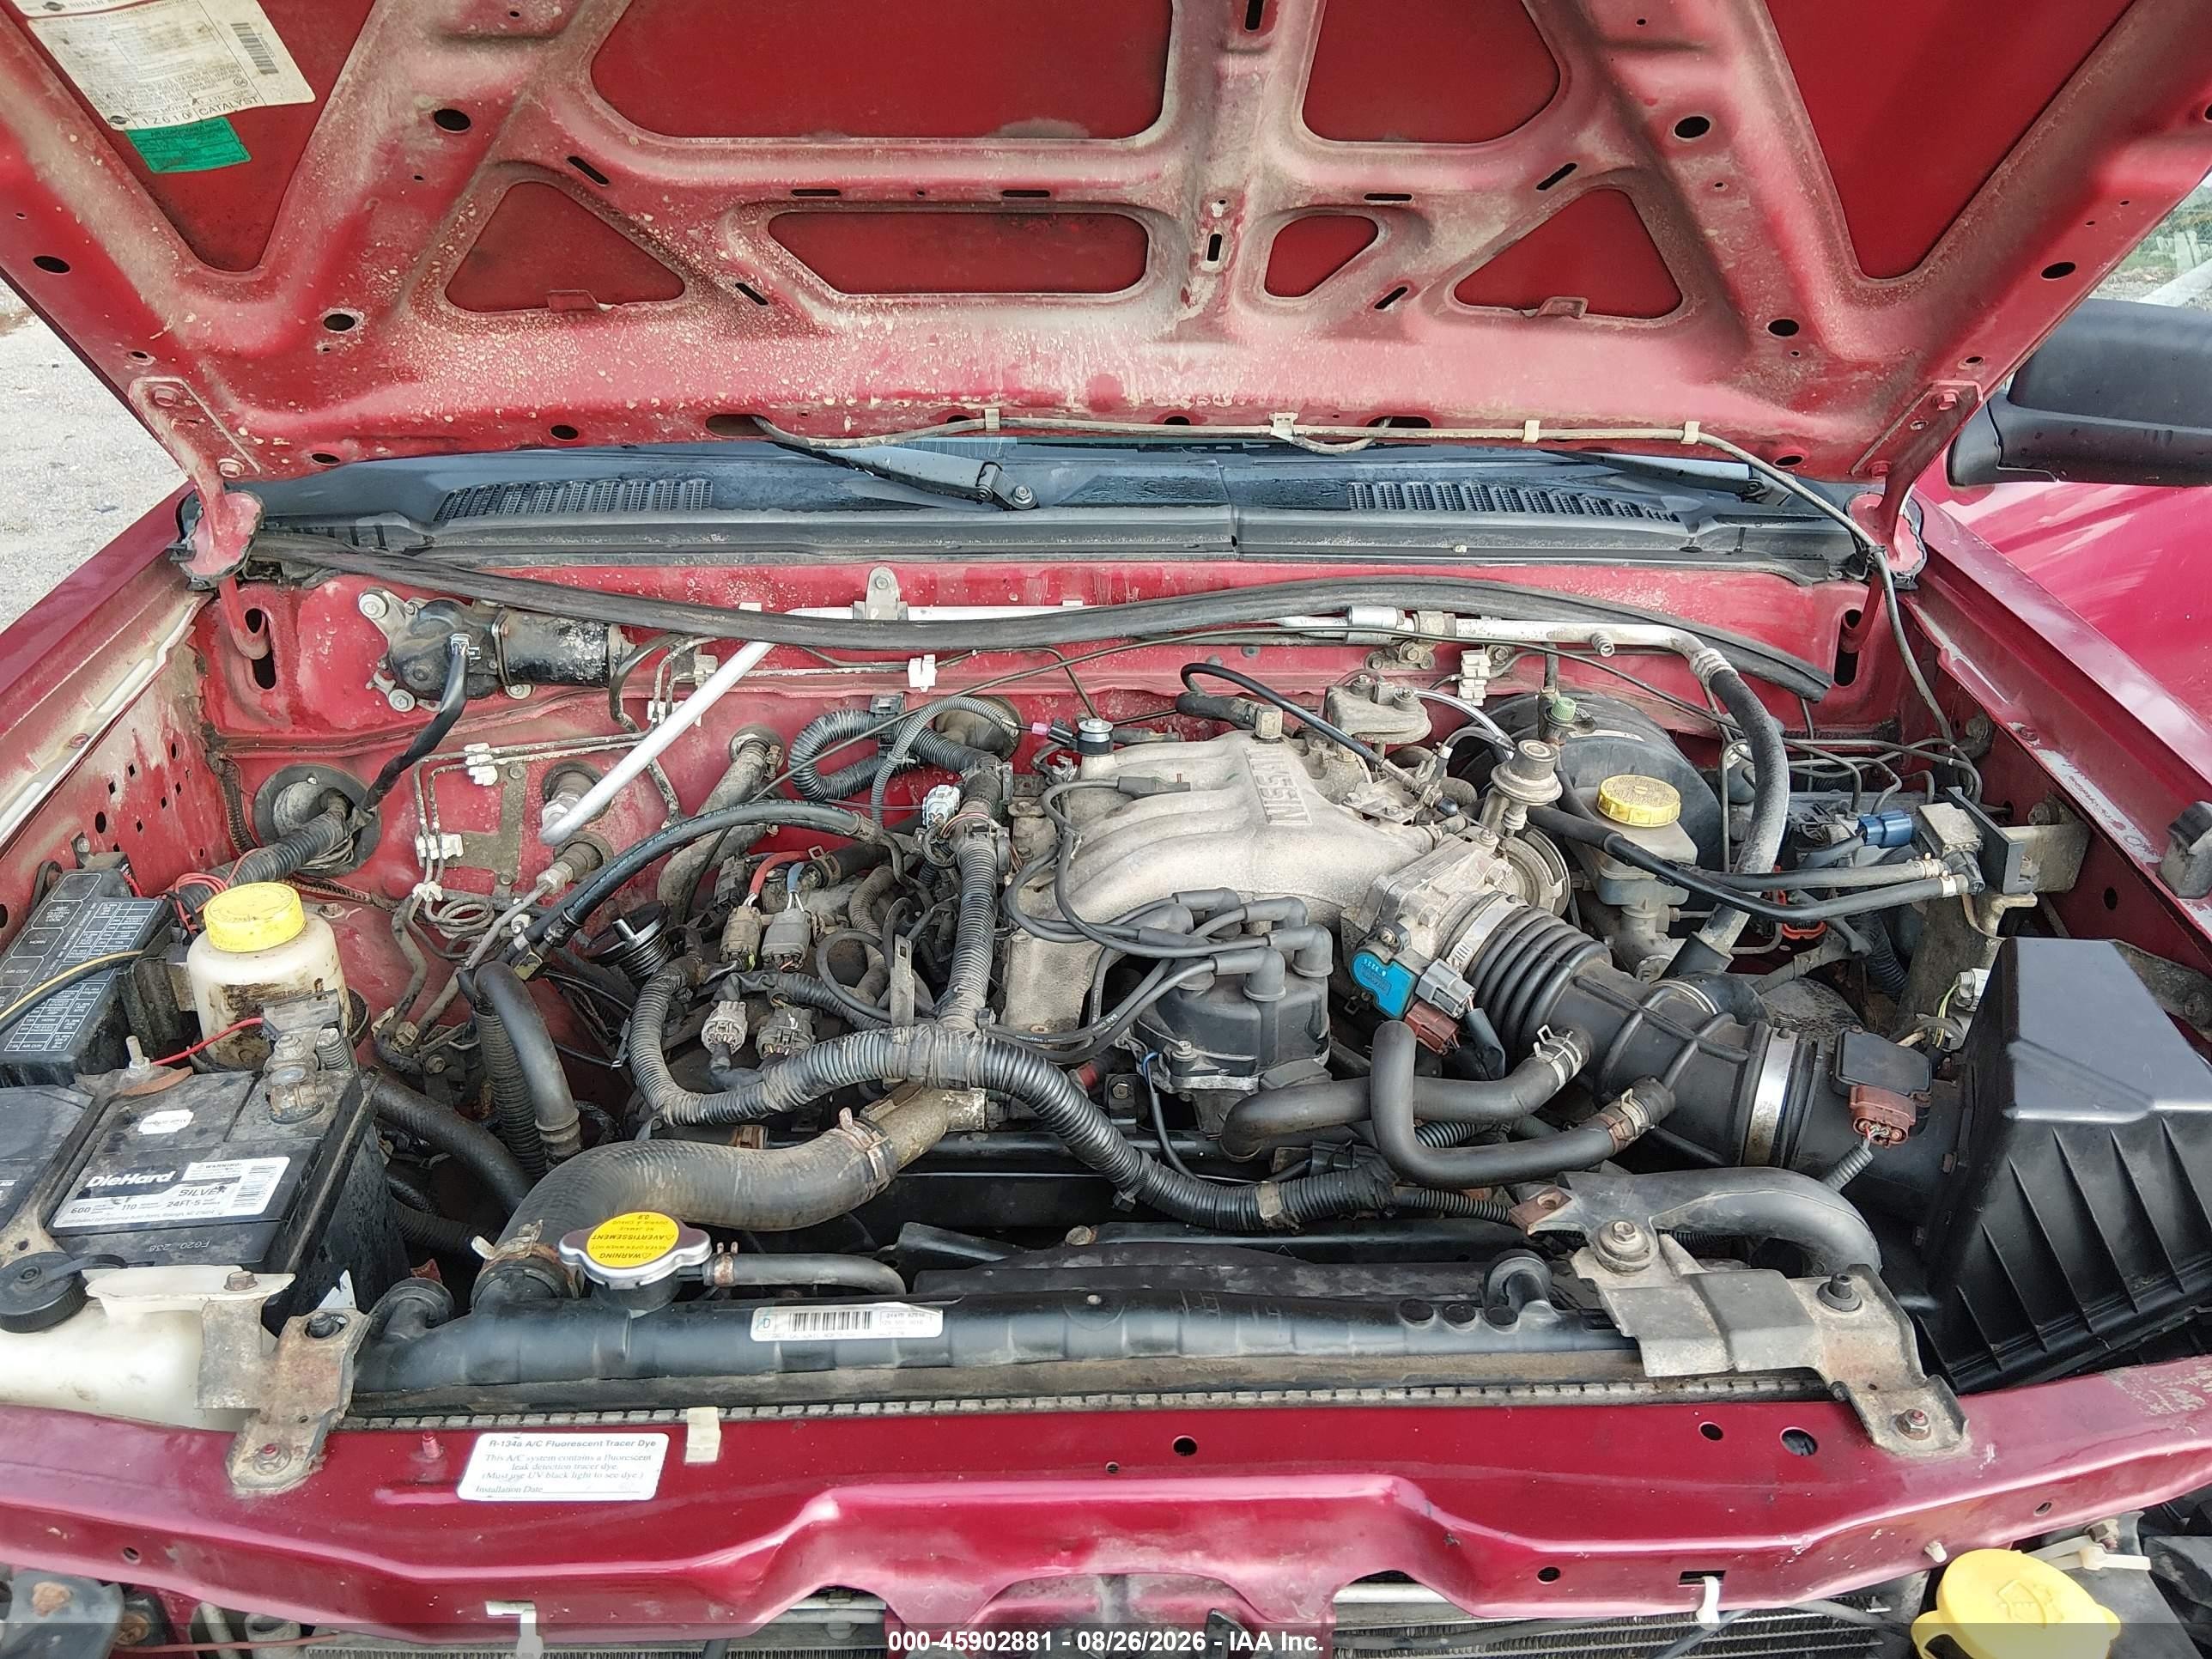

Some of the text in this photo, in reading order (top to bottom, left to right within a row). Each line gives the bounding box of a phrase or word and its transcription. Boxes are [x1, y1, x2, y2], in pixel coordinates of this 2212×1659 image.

[199, 96, 259, 117] CATALYST
[1243, 747, 1312, 824] NISSAN
[85, 1170, 177, 1188] DieHard
[178, 1185, 228, 1197] SILVER
[489, 1439, 657, 1449] R-134a A/C Fluorescent Tracer Dye
[526, 1455, 556, 1464] system
[512, 1462, 529, 1471] leak
[599, 1463, 618, 1473] dye.
[546, 1471, 569, 1480] black
[571, 1471, 592, 1481] light
[475, 1485, 521, 1494] Installation
